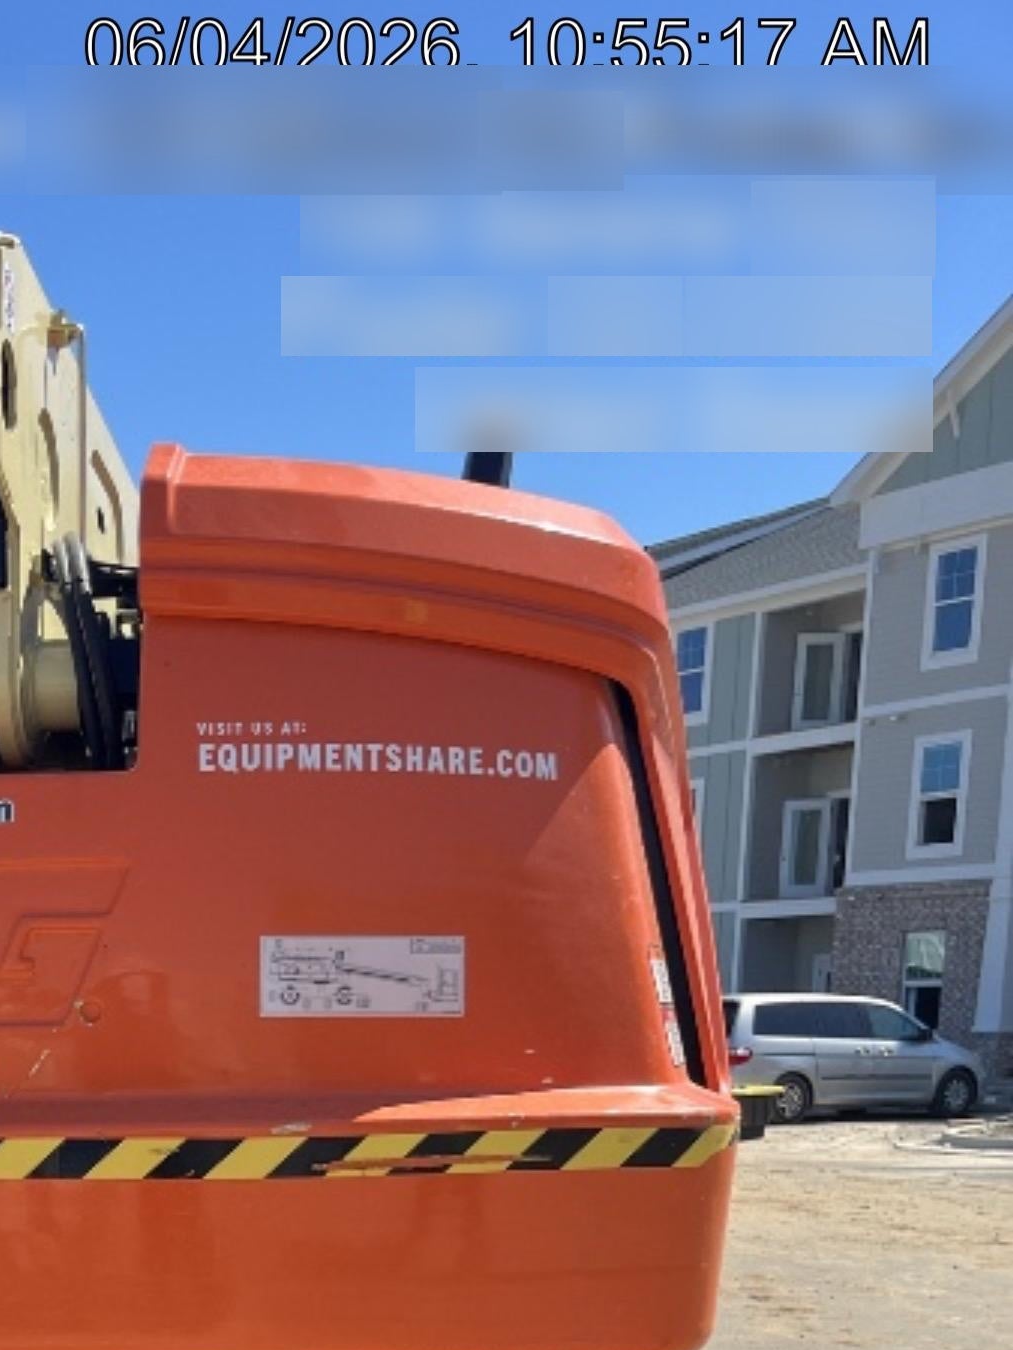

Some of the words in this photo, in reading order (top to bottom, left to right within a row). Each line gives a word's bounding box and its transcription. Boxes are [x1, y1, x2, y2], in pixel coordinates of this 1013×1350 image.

[195, 721, 243, 736] VISIT
[250, 721, 274, 736] US
[280, 721, 307, 736] AT:
[197, 742, 559, 782] EQUIPMENTSHARE.COM
